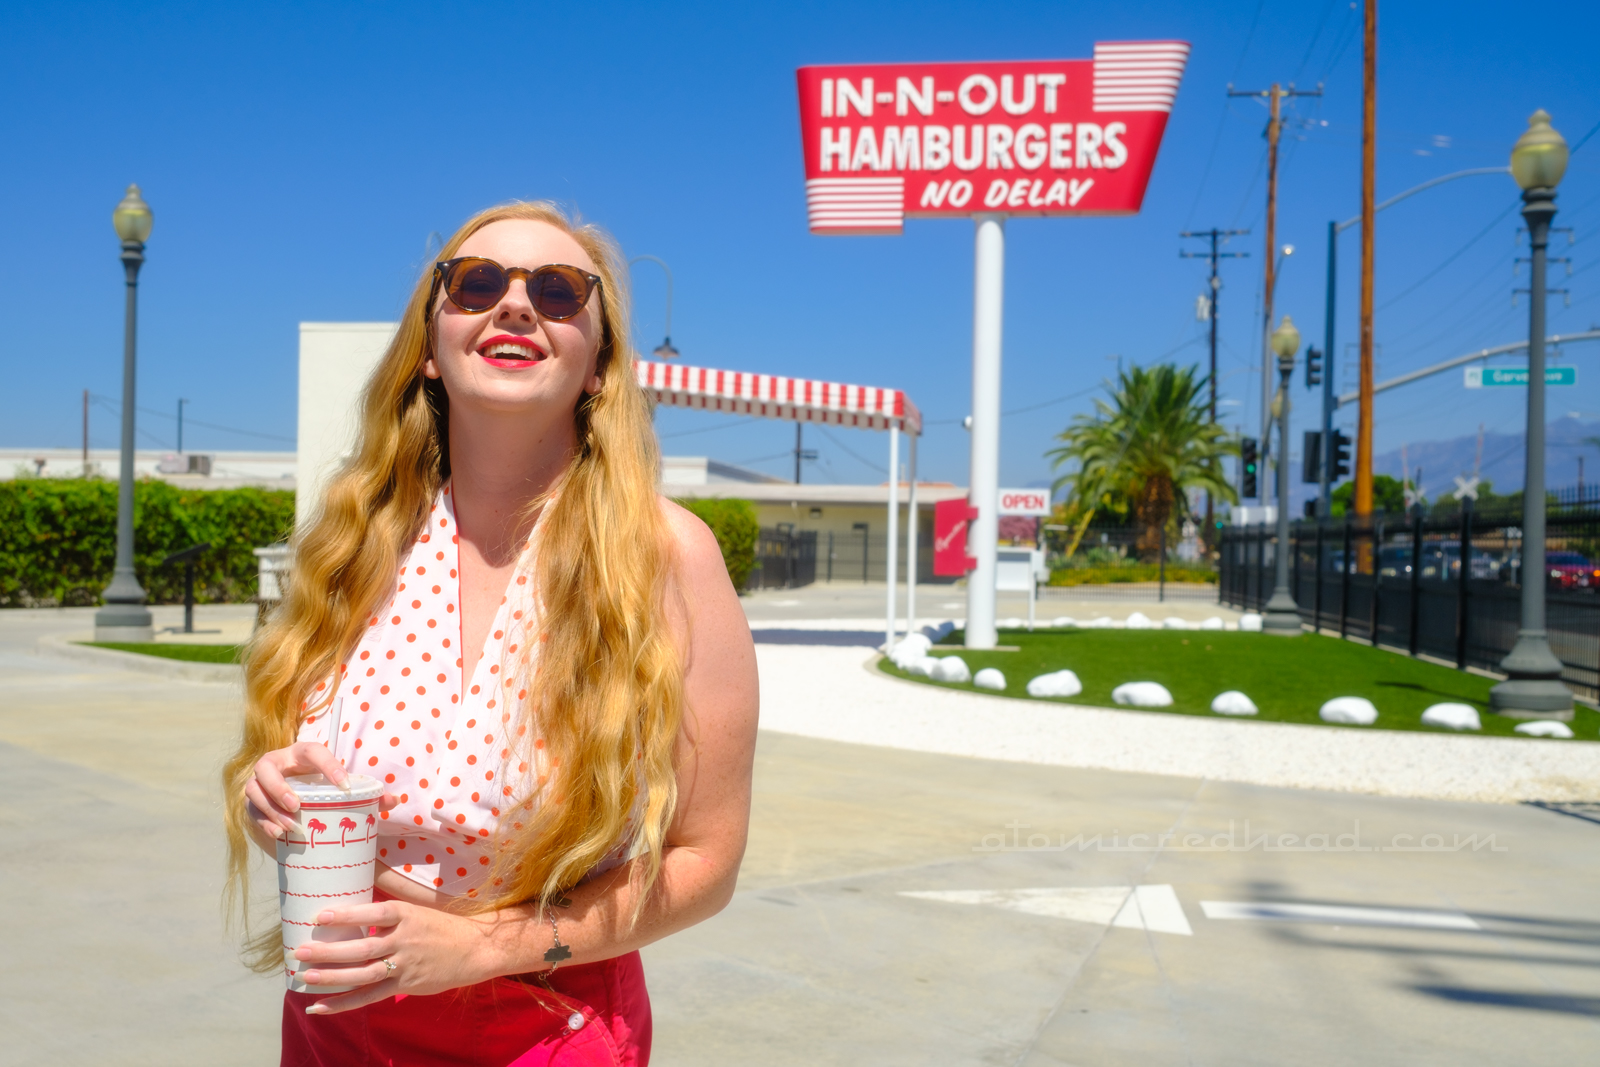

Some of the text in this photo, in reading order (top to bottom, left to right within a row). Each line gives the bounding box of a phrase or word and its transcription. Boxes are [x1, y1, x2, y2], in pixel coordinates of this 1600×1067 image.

[820, 74, 1066, 118] IN-N-OUT
[819, 122, 1128, 172] HAMBURGERS
[920, 178, 1095, 208] NO DELAY
[1002, 494, 1045, 509] OPEN
